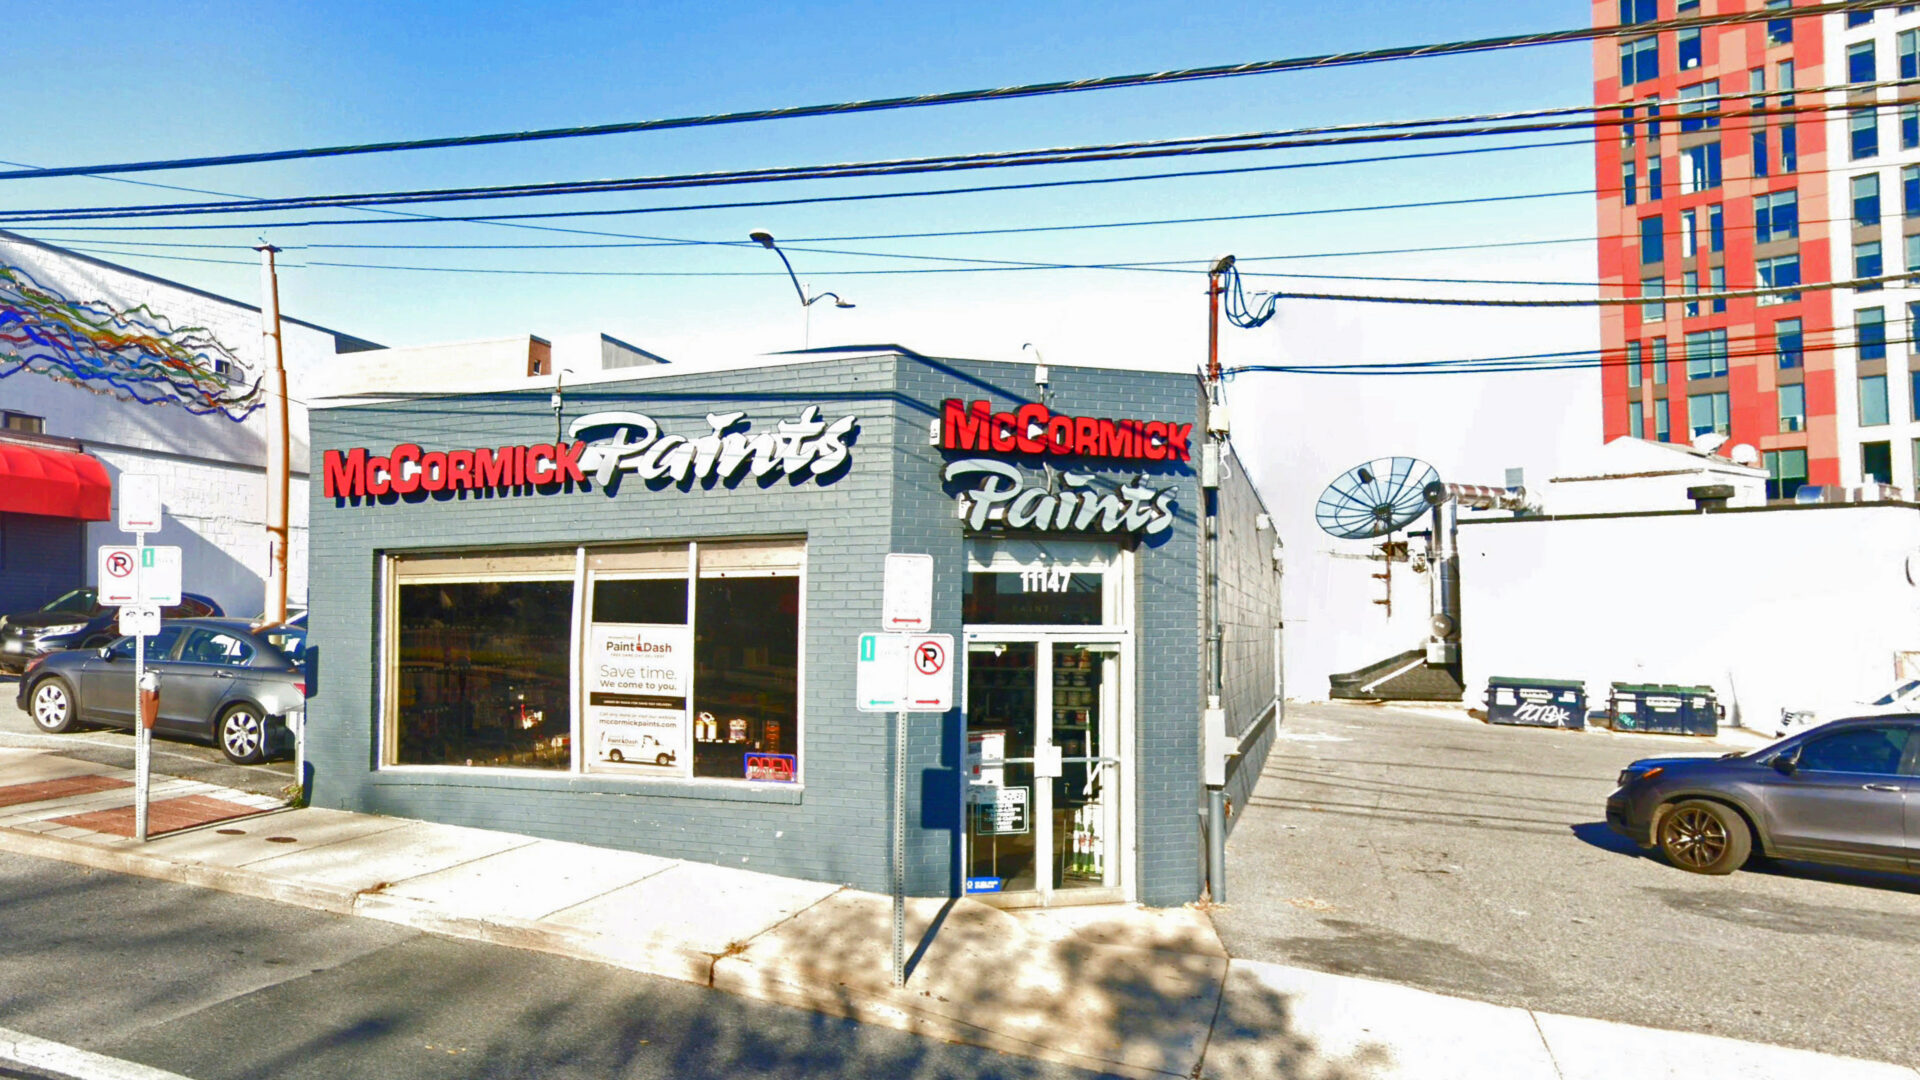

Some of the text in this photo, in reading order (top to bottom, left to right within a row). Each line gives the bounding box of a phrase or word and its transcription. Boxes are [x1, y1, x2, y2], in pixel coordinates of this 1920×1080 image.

[568, 405, 857, 487] Paints
[941, 458, 1179, 535] Paints
[1020, 571, 1070, 593] 11147
[606, 641, 672, 653] Paint Dash
[600, 664, 677, 680] Save time.
[600, 680, 677, 692] We come to you.
[599, 719, 677, 728] mccormickpaints.com
[747, 757, 793, 780] OPEN
